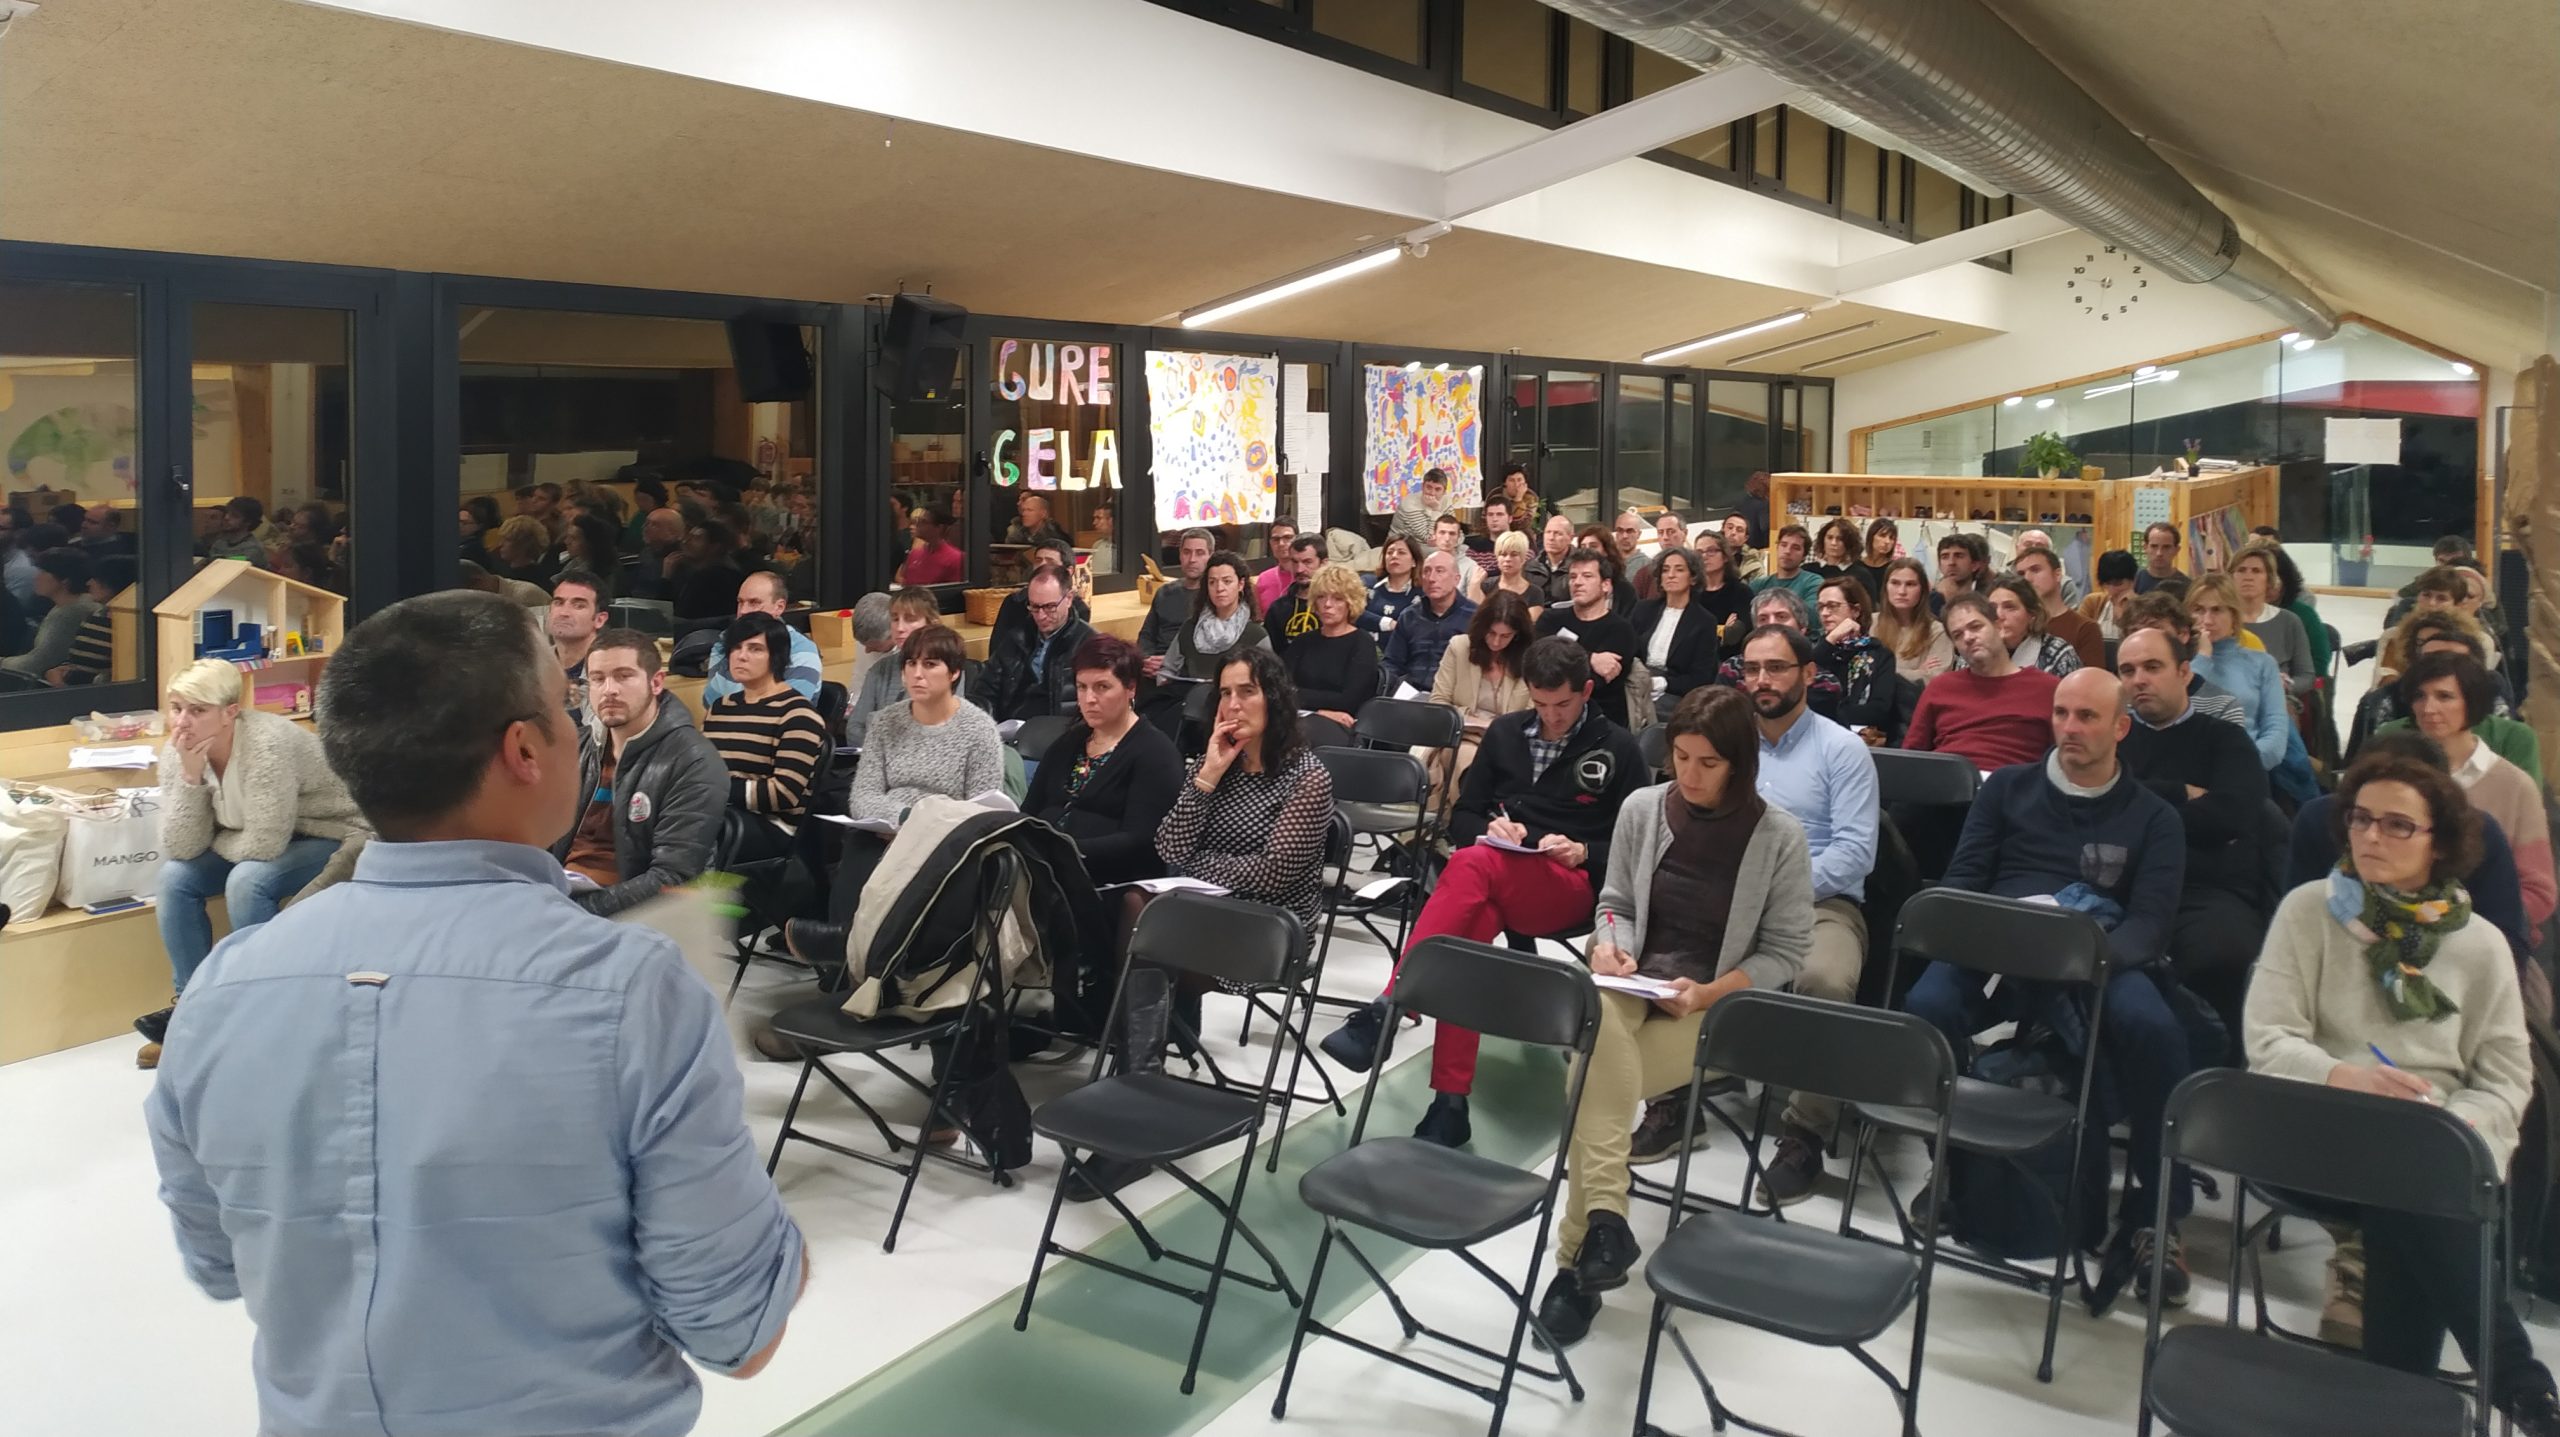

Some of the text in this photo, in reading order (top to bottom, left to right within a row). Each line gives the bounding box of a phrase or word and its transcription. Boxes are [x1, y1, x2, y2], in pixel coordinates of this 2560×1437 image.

[2104, 246, 2117, 254] 12
[2132, 266, 2141, 274] 2
[2139, 280, 2147, 288] 3
[2101, 313, 2109, 321] 6
[999, 340, 1111, 405] GURE
[993, 428, 1123, 491] GELA
[93, 850, 159, 867] MANGO
